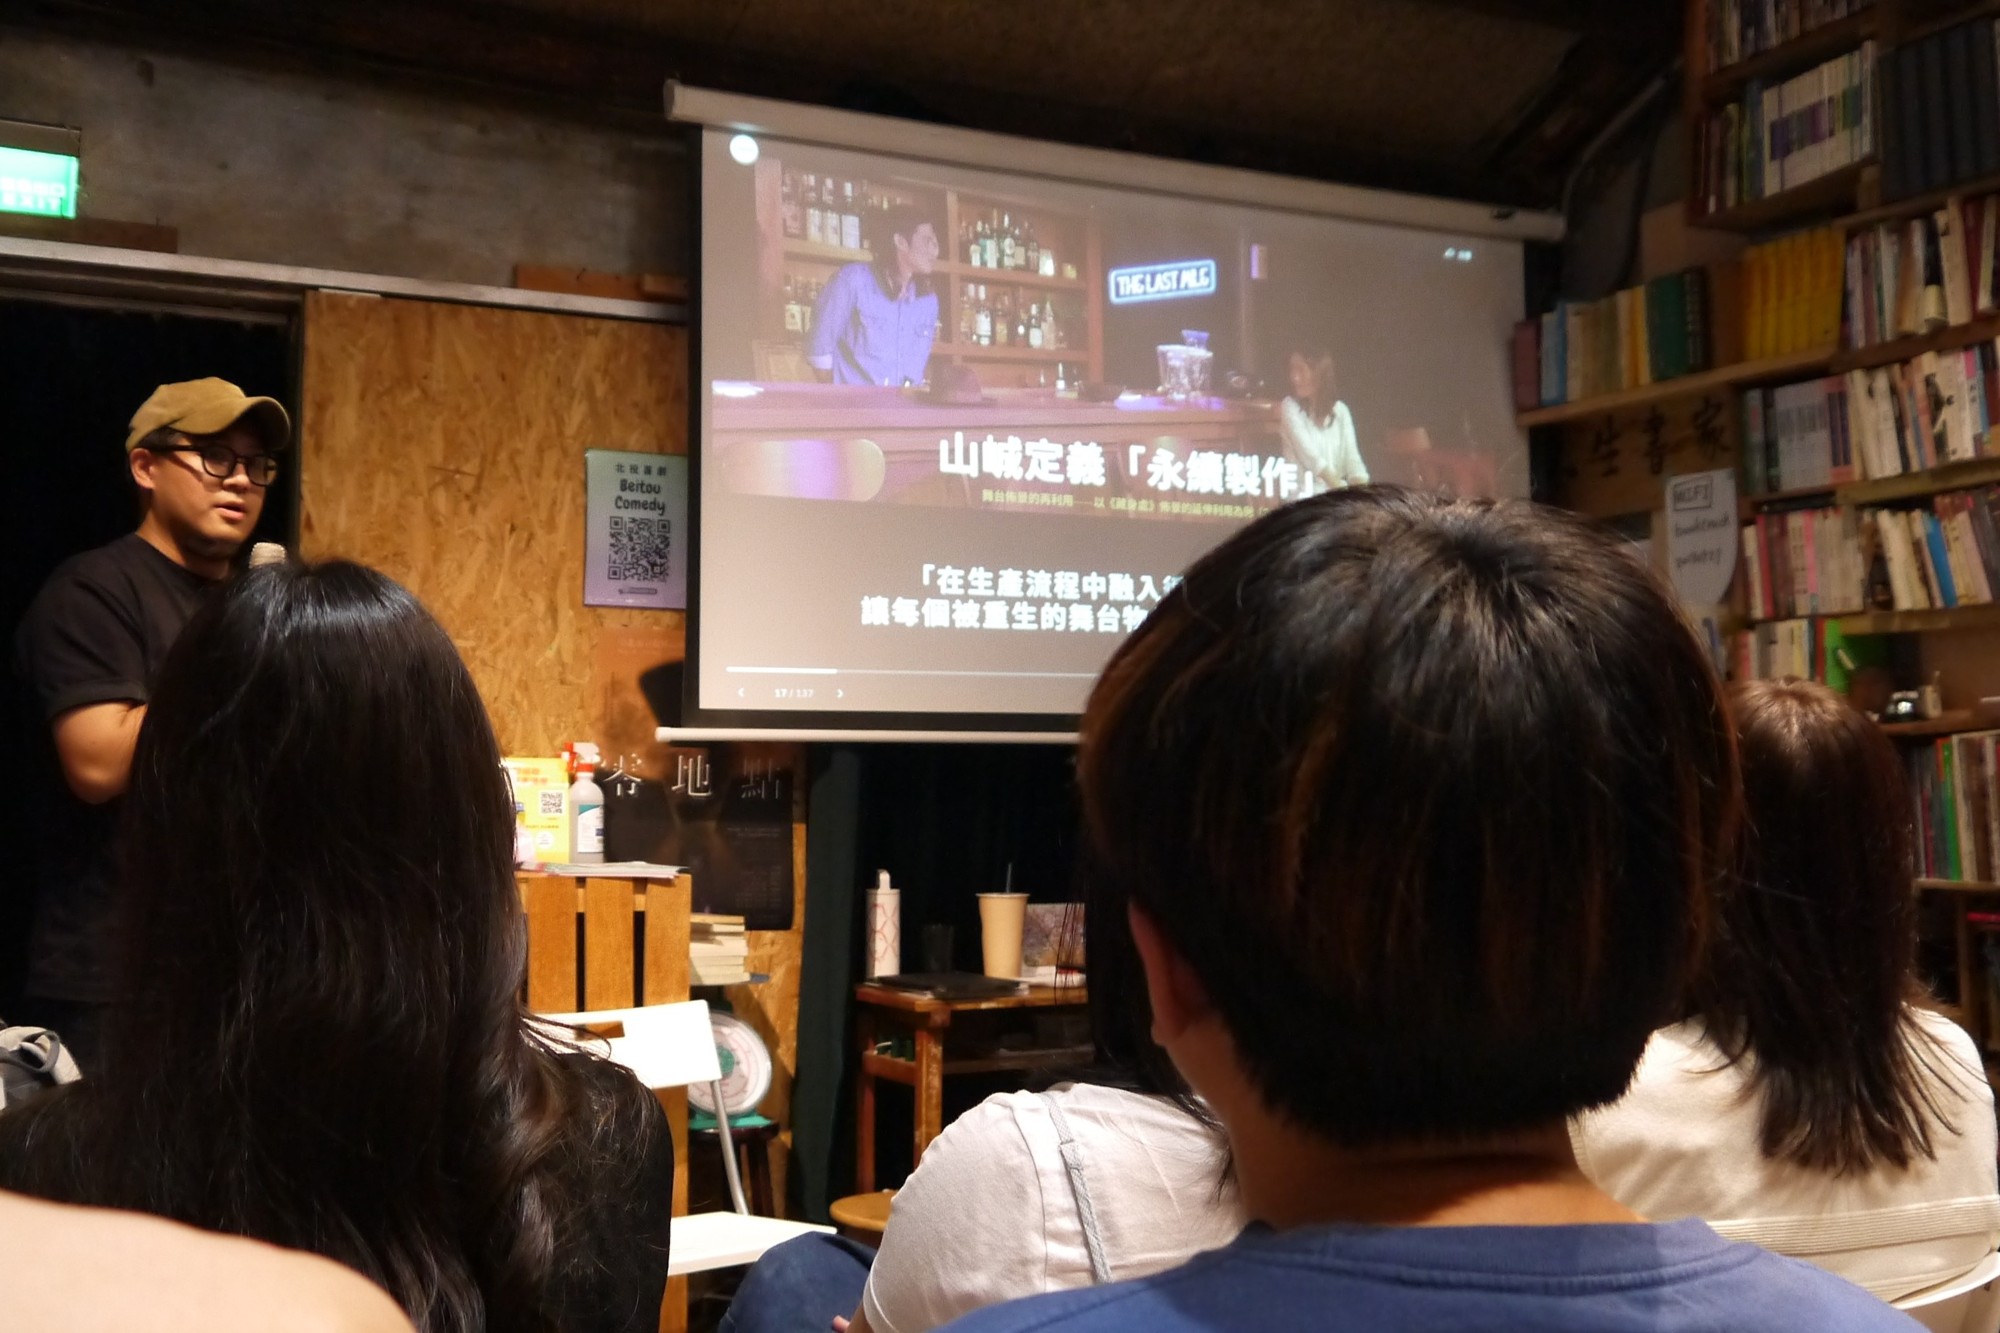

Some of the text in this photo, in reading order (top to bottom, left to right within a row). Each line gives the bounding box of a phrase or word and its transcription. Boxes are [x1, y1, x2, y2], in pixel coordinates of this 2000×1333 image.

[1117, 273, 1145, 296] THE
[1145, 270, 1179, 293] LAST
[619, 479, 661, 494] Beitou
[614, 495, 666, 516] Comedy
[774, 688, 788, 698] 17
